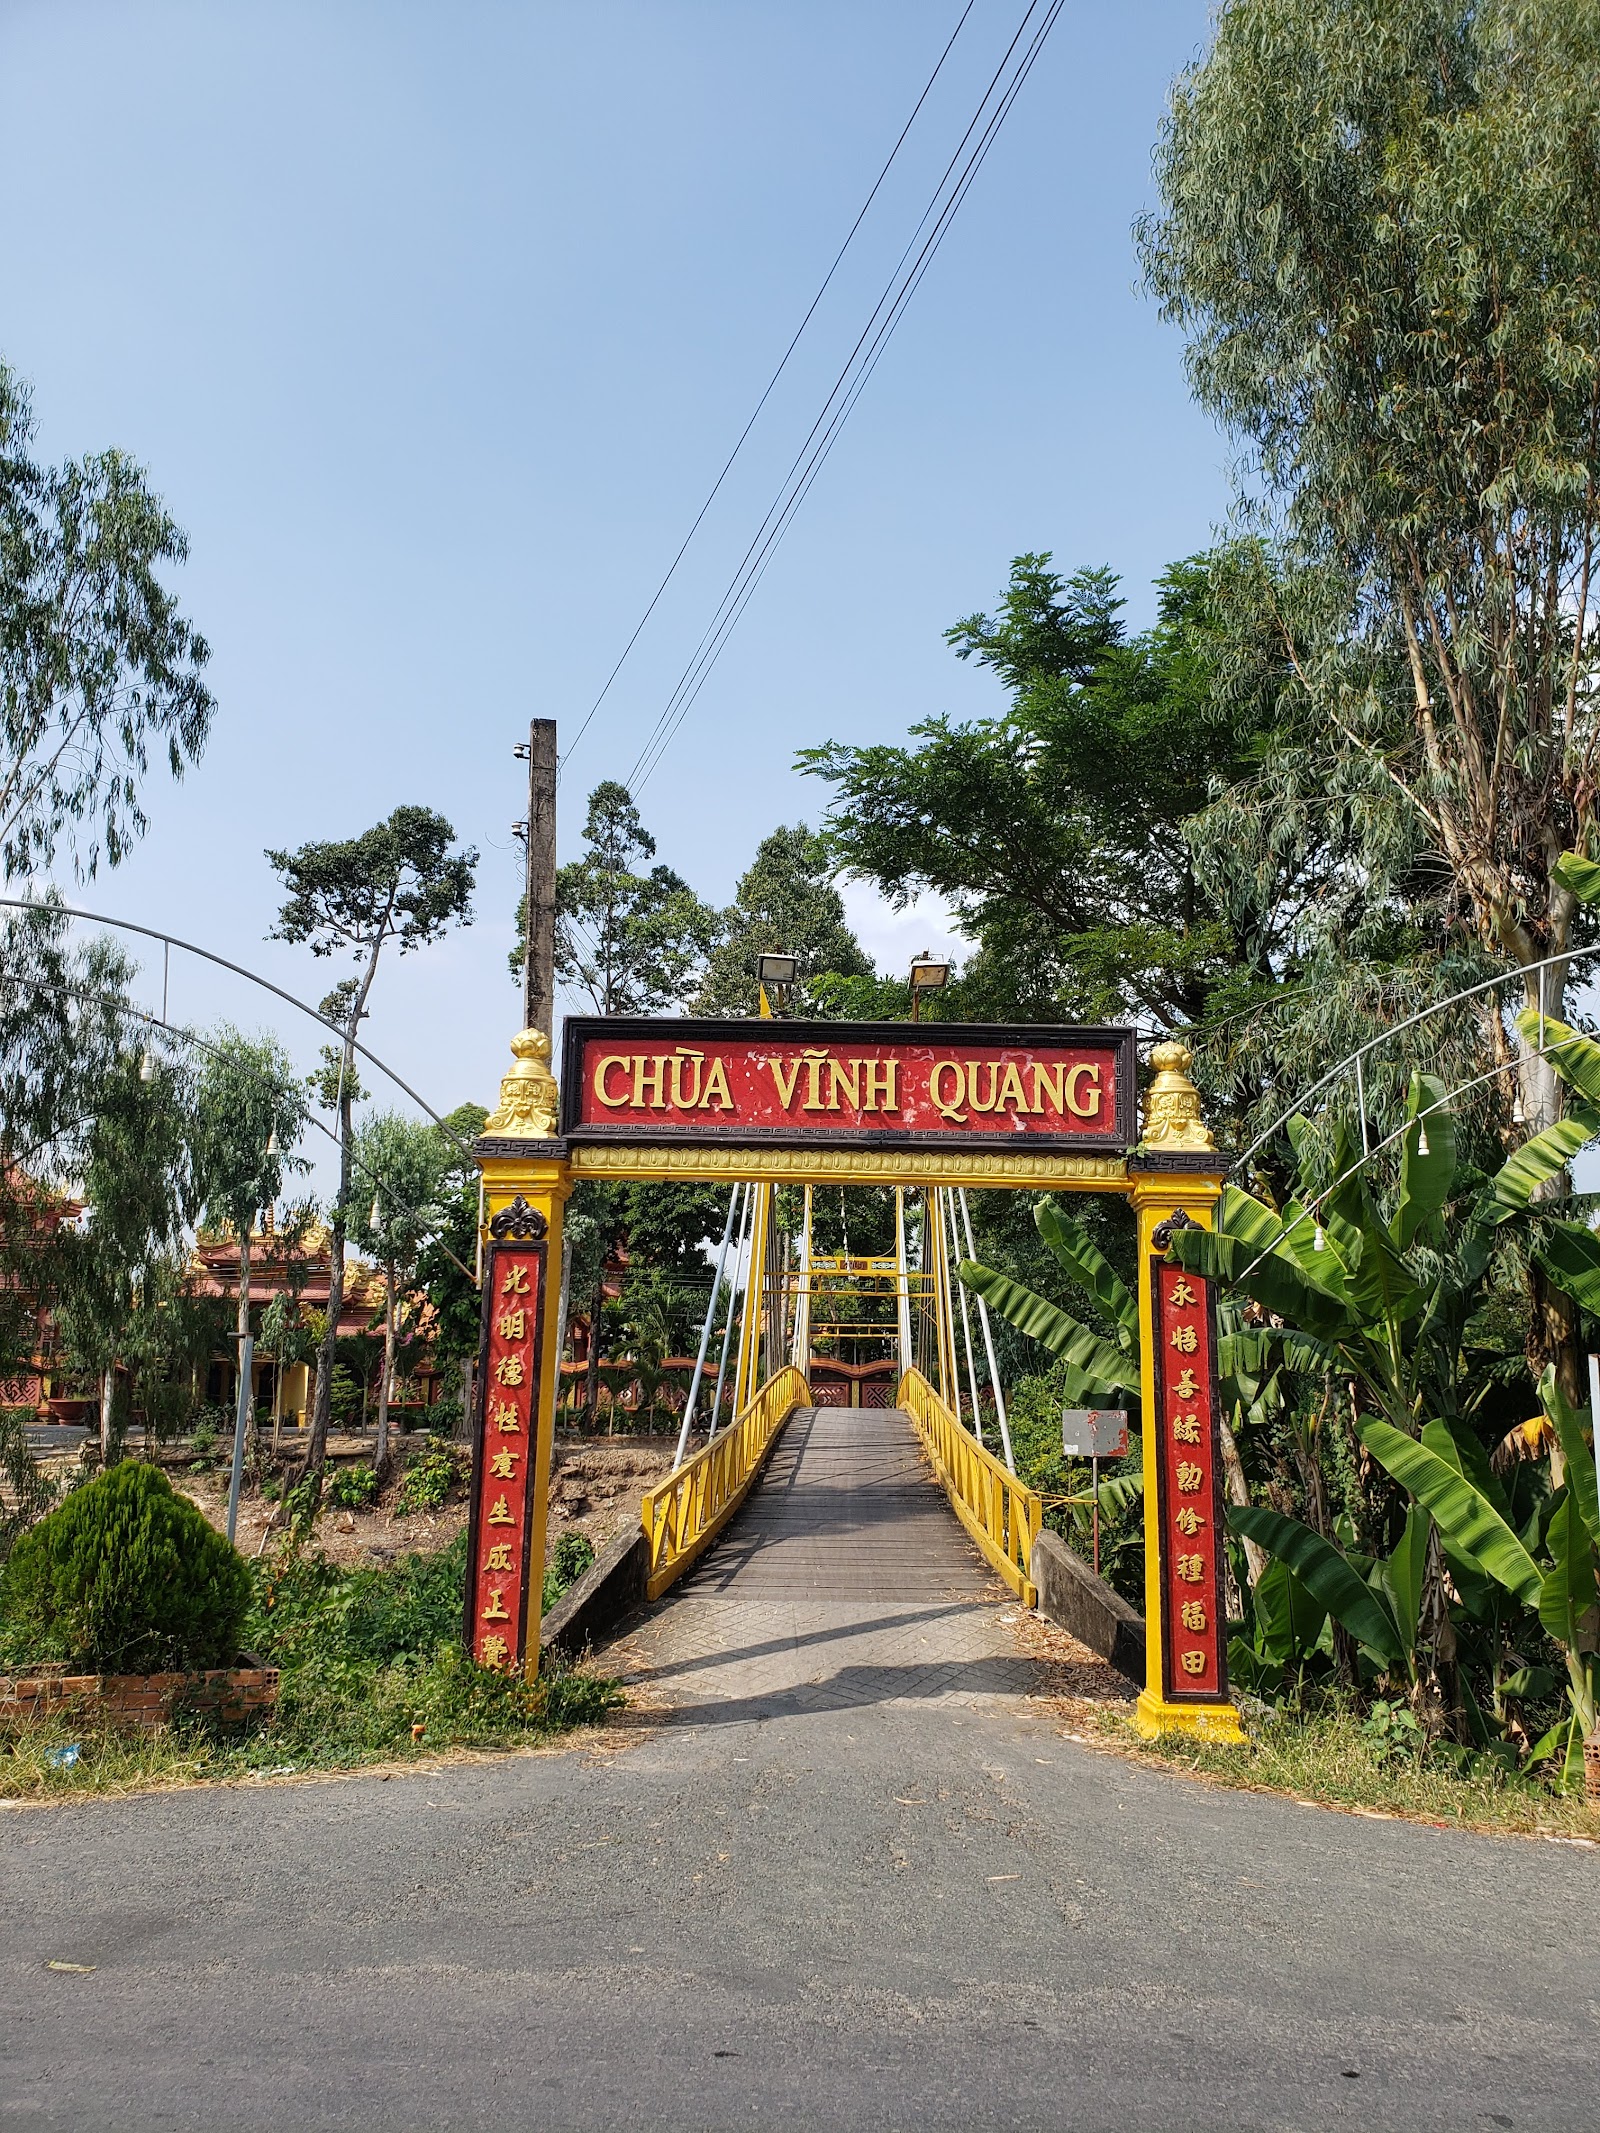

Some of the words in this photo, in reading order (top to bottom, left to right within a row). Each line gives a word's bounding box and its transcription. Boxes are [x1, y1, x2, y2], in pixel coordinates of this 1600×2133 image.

[593, 1047, 734, 1111] CHÙA
[769, 1048, 899, 1112] VĨNH
[929, 1060, 1102, 1123] QUANG
